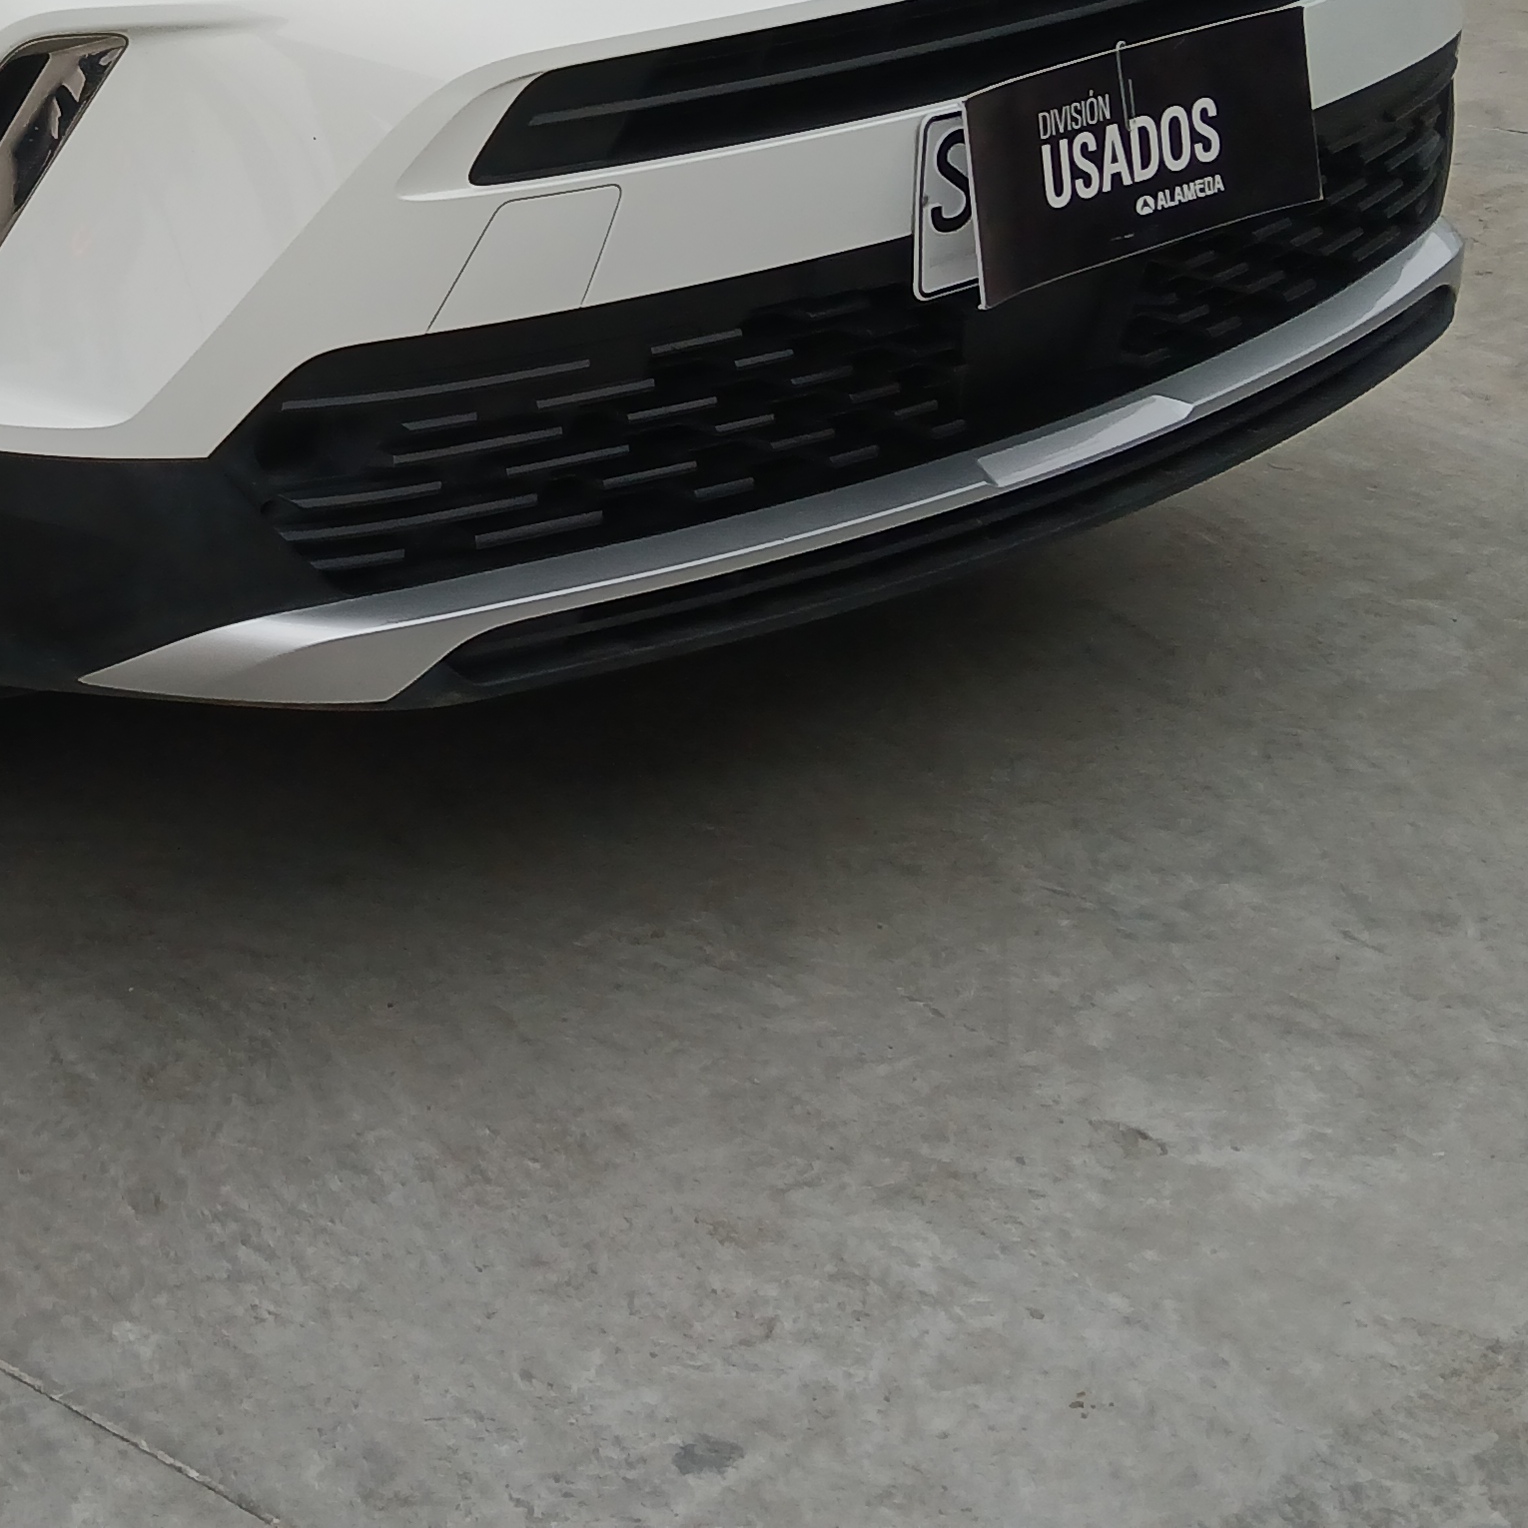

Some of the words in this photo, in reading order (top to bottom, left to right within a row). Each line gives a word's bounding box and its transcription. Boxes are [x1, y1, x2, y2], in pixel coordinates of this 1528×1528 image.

[1038, 89, 1111, 140] DIVISIÓN
[1041, 97, 1221, 209] USADOS
[1157, 174, 1225, 210] ALAMEDA
